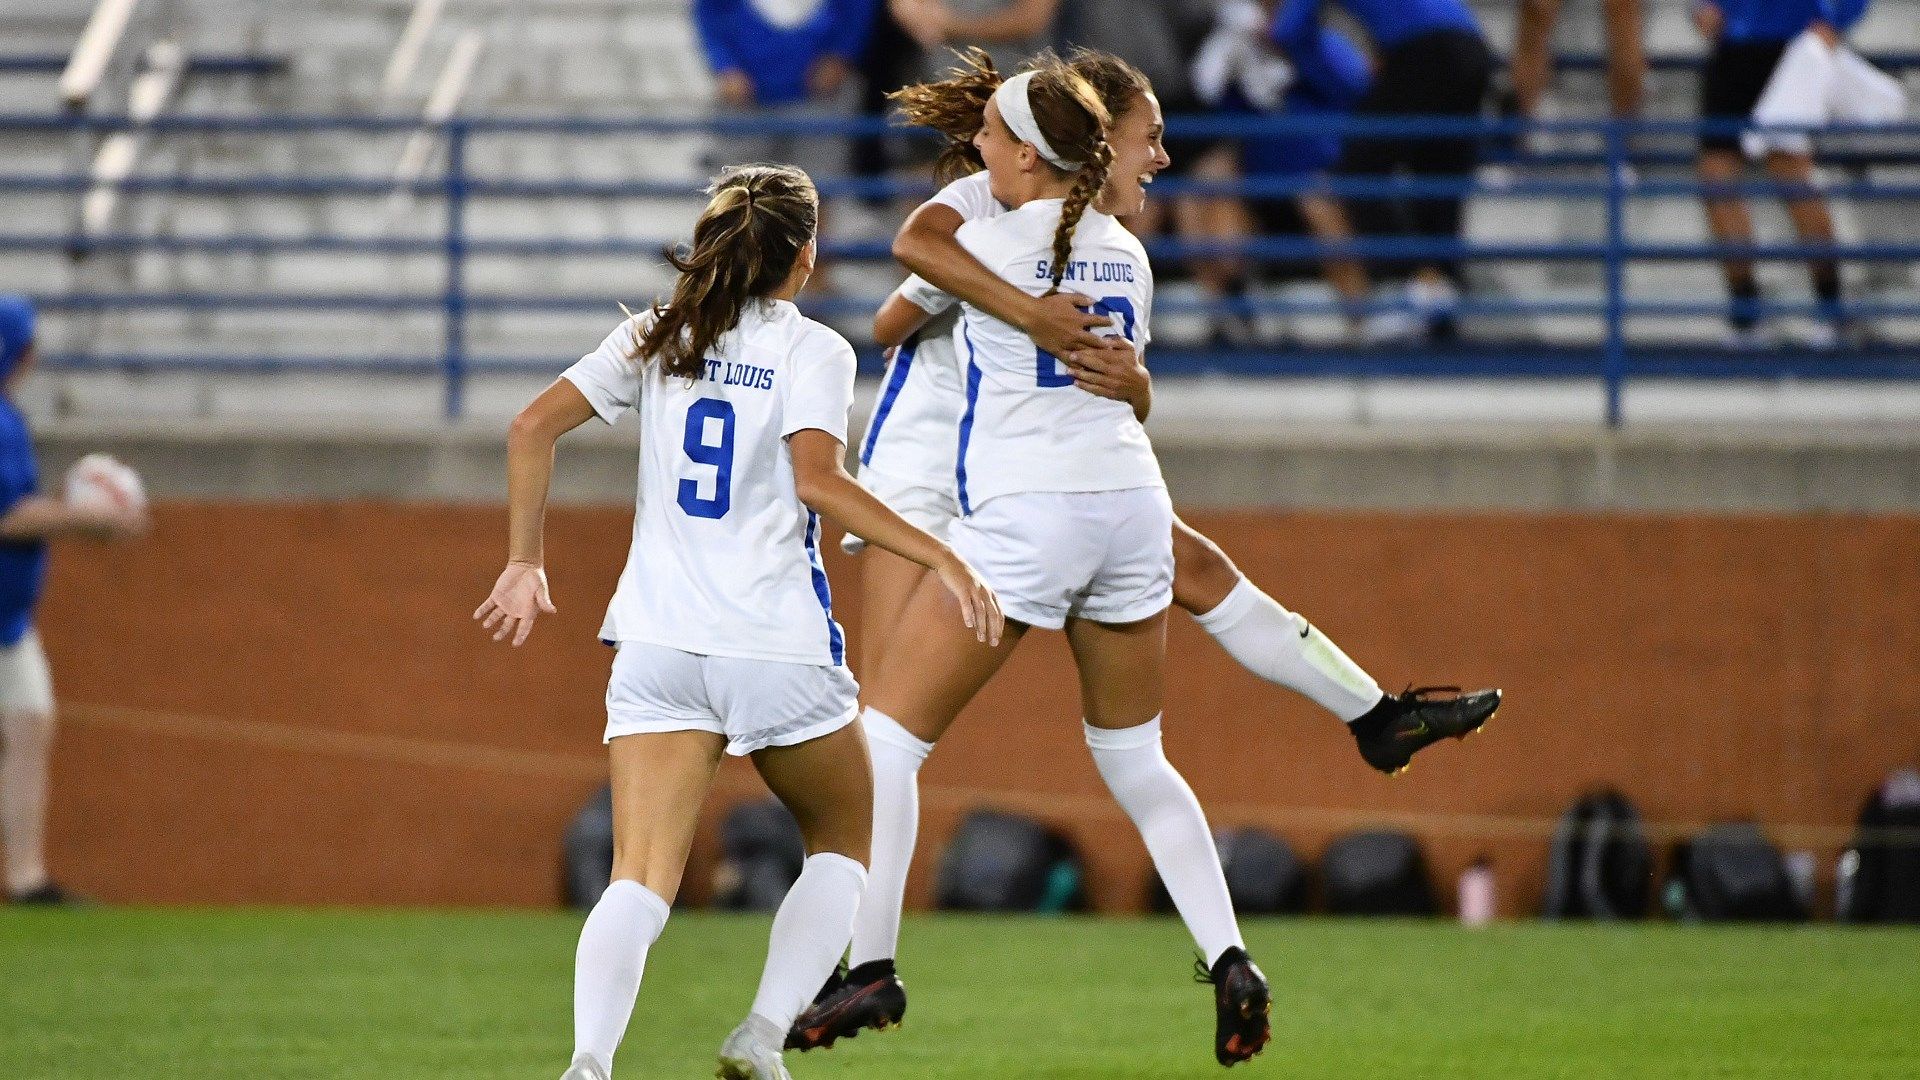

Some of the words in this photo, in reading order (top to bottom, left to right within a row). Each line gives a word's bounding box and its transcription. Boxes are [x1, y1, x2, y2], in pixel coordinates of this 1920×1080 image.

[1035, 260, 1088, 281] SANT
[1093, 261, 1134, 283] LOUIS
[723, 362, 775, 390] LOUIS
[676, 397, 736, 520] 9
